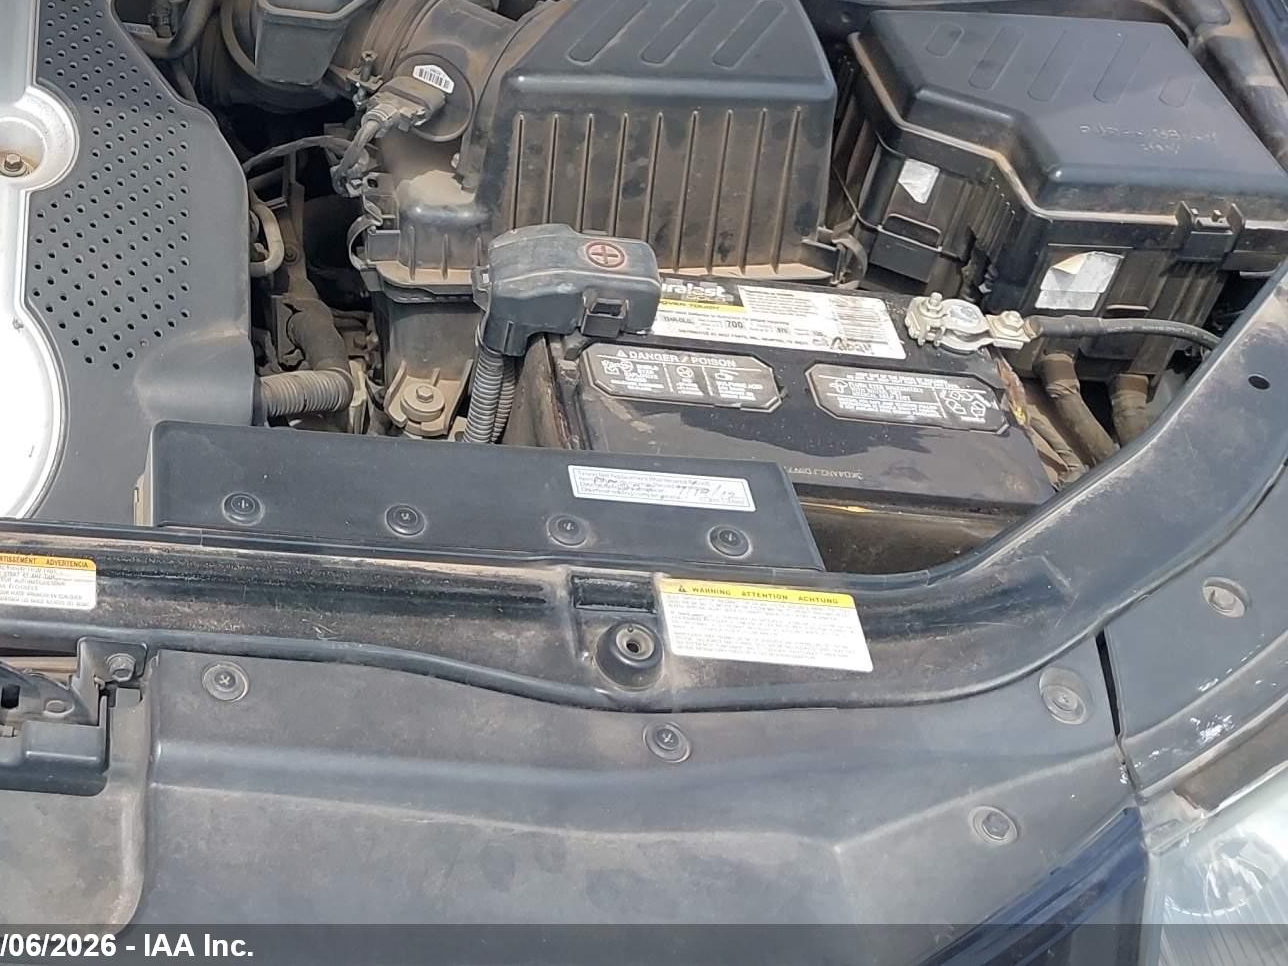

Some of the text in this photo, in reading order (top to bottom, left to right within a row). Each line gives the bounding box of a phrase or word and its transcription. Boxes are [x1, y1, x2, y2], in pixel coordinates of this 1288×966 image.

[629, 352, 680, 363] DANGER
[691, 357, 736, 368] POISON
[45, 558, 89, 569] ADVERTENCIA
[692, 587, 839, 605] WARNING ATTENTION ACHTUNG
